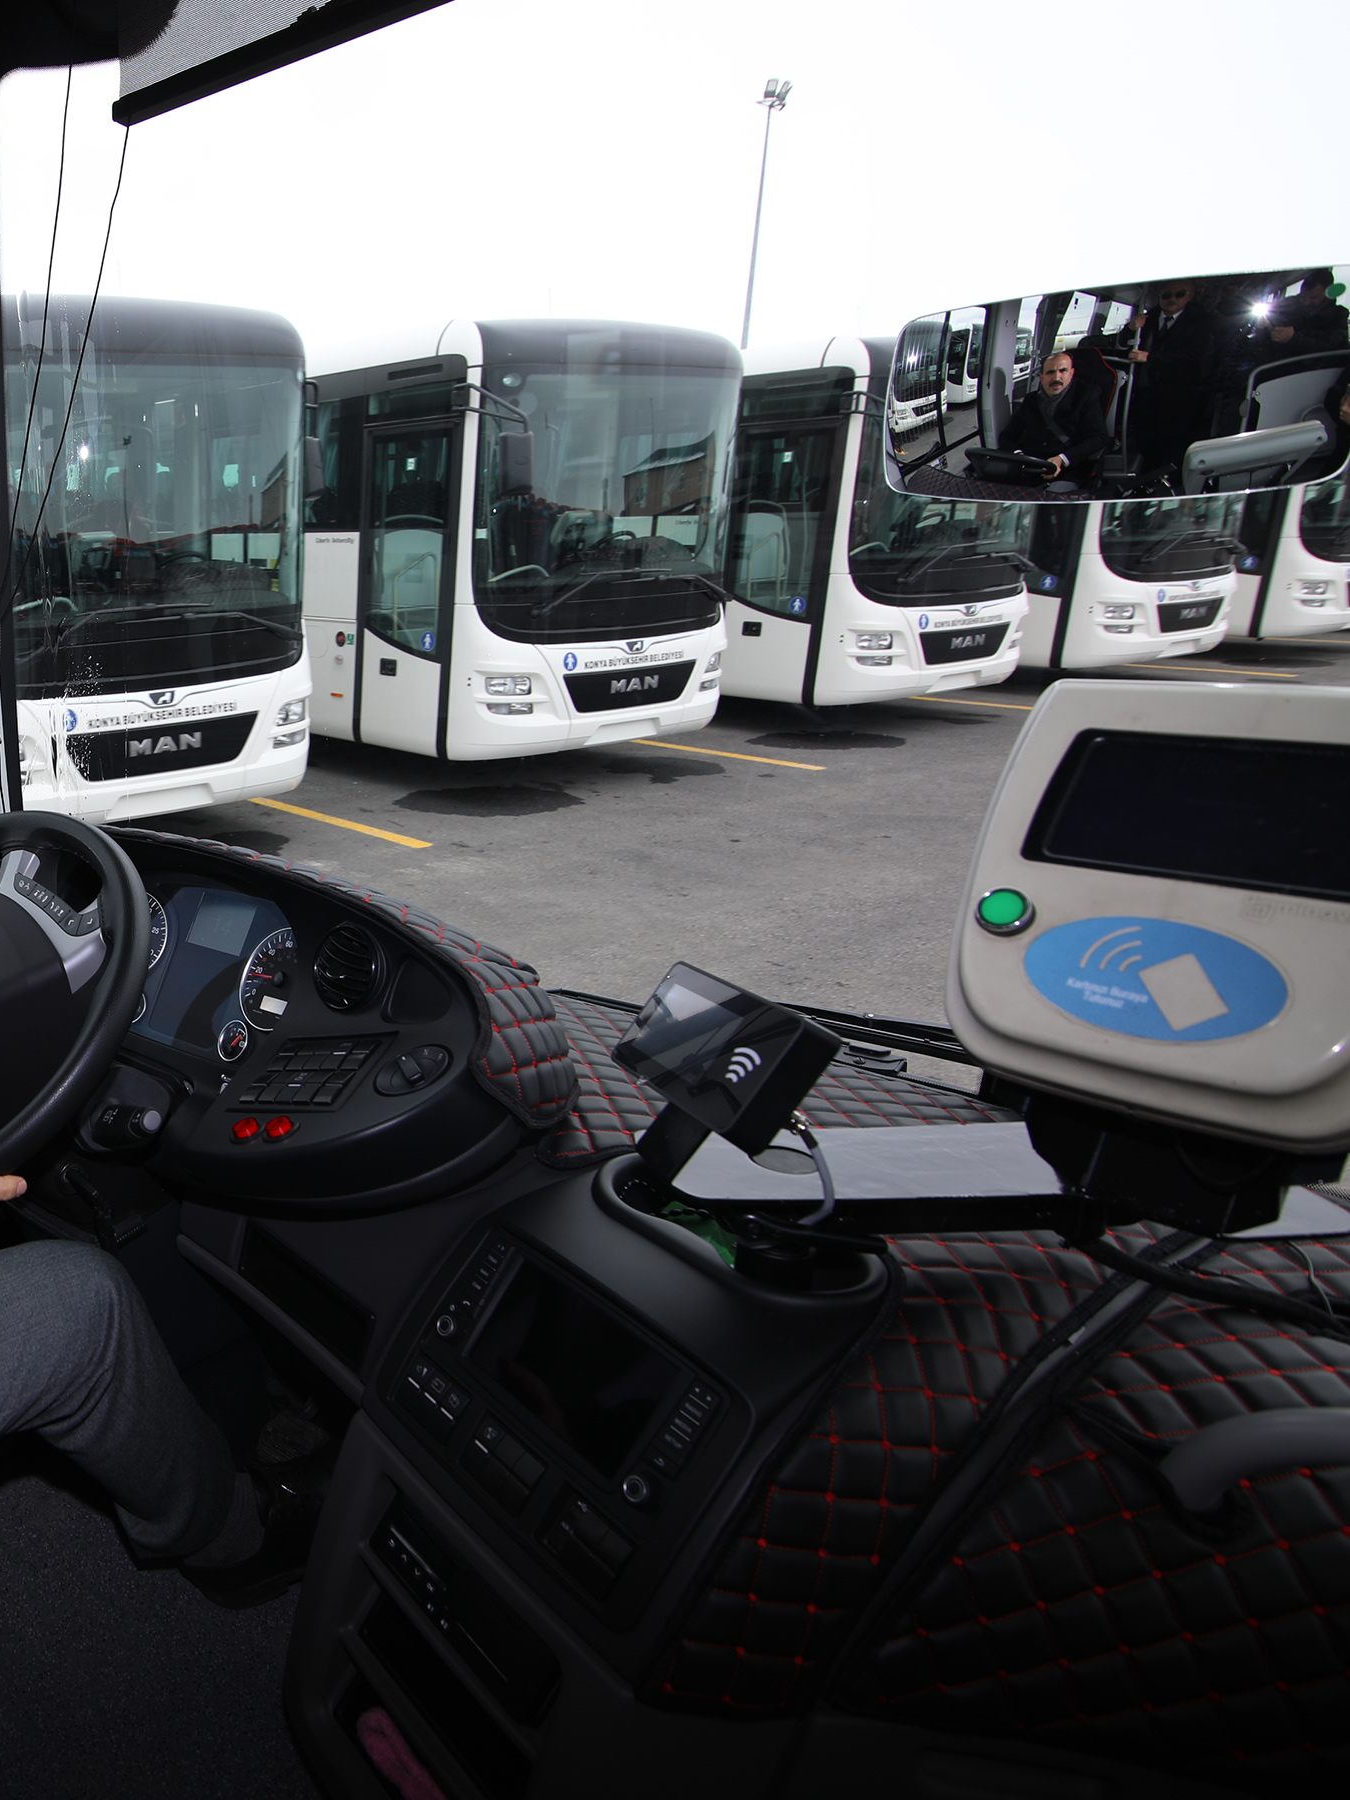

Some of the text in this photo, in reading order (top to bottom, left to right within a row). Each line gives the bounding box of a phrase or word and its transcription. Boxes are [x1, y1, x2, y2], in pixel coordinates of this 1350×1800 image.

[950, 634, 986, 649] MAN
[583, 659, 607, 670] KONYA
[610, 675, 659, 694] MAN
[88, 716, 121, 729] KONYA
[129, 732, 202, 757] MAN
[255, 966, 264, 975] 20
